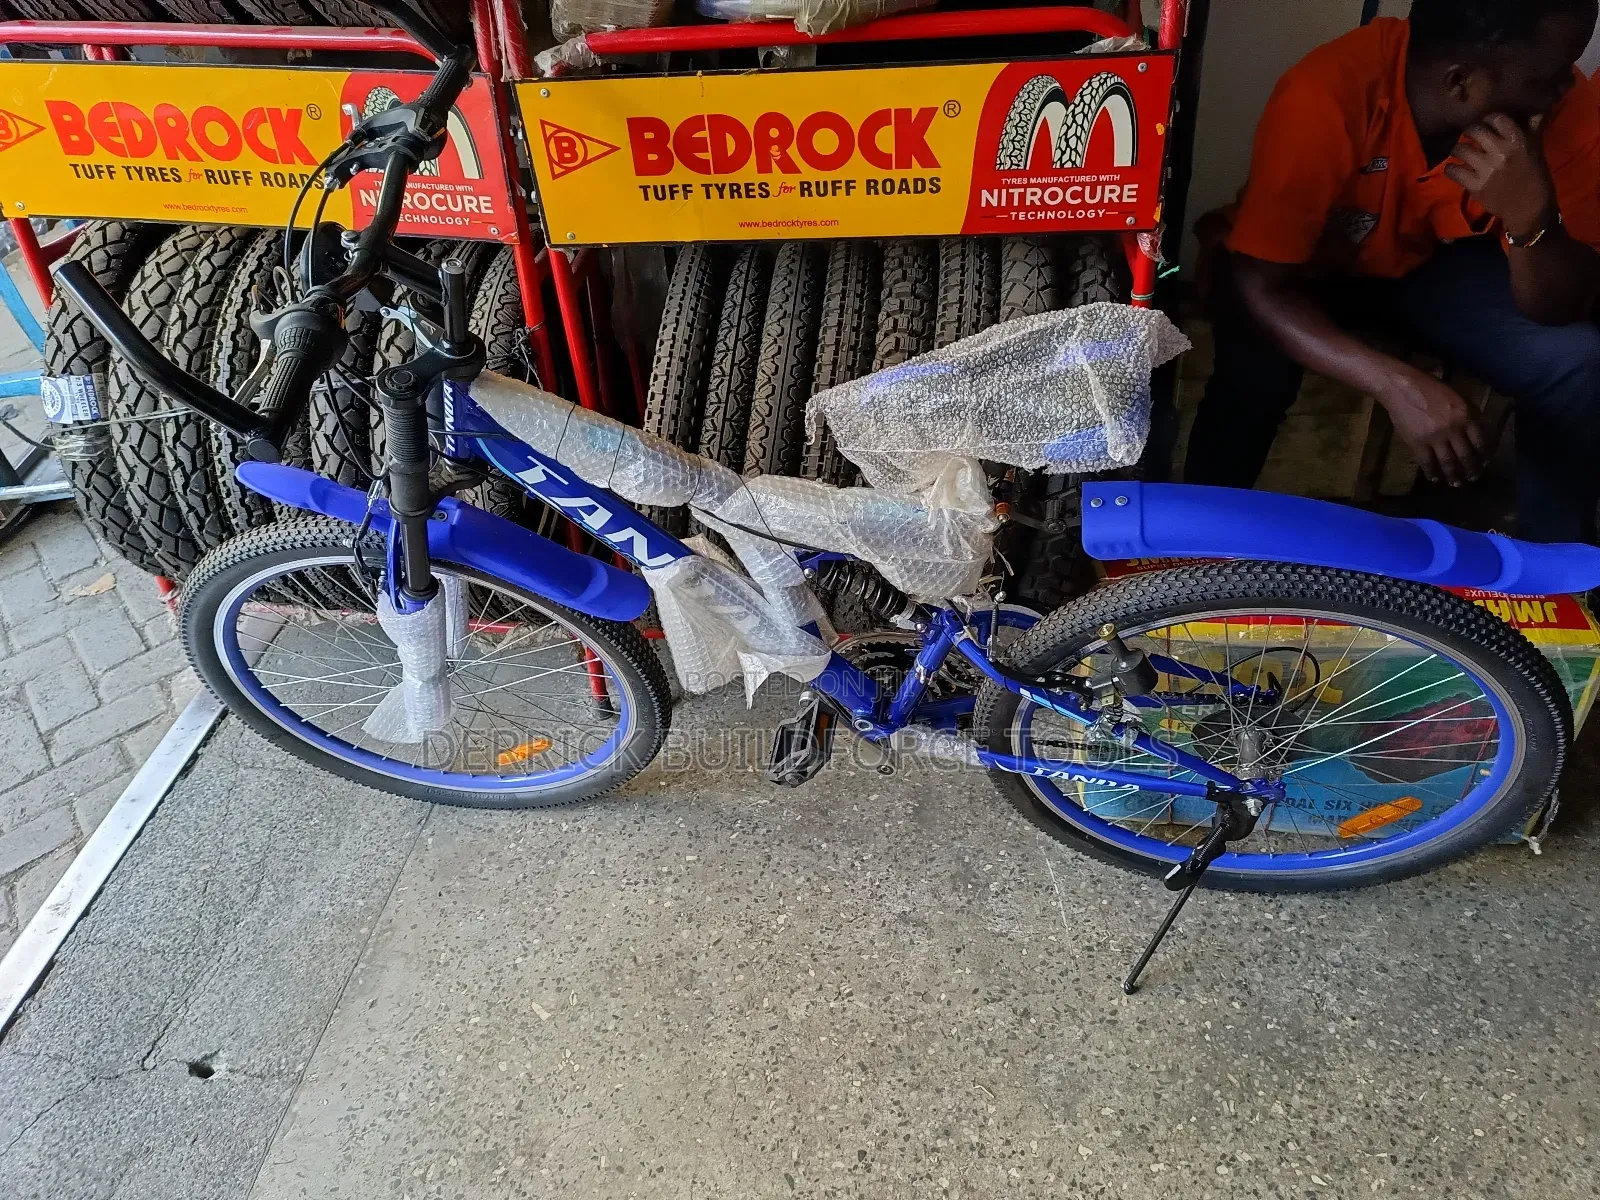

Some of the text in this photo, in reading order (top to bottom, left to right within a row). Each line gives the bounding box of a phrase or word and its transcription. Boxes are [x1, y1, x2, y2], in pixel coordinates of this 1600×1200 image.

[45, 100, 320, 166] BEDROCK
[626, 106, 942, 177] BEDROCK
[69, 163, 326, 190] TUFF TYRES for RUFF ROADS
[405, 181, 475, 193] NUFACTURED WITH
[1001, 174, 1121, 185] TYRES MANUFACTURED WITH
[638, 176, 942, 202] TUFF TYRES for RUFF ROADS
[981, 184, 1139, 207] NITROCURE
[163, 202, 249, 214] www.bedrocktyres.com
[359, 189, 494, 214] NROCURE
[399, 213, 470, 226] ECHNOLOGY
[738, 217, 839, 230] www.bedrocktyres.com
[1010, 209, 1106, 221] TECHNOLOGY
[86, 384, 101, 416] BEDROCK
[515, 455, 677, 569] TAN
[1473, 599, 1558, 623] JMA
